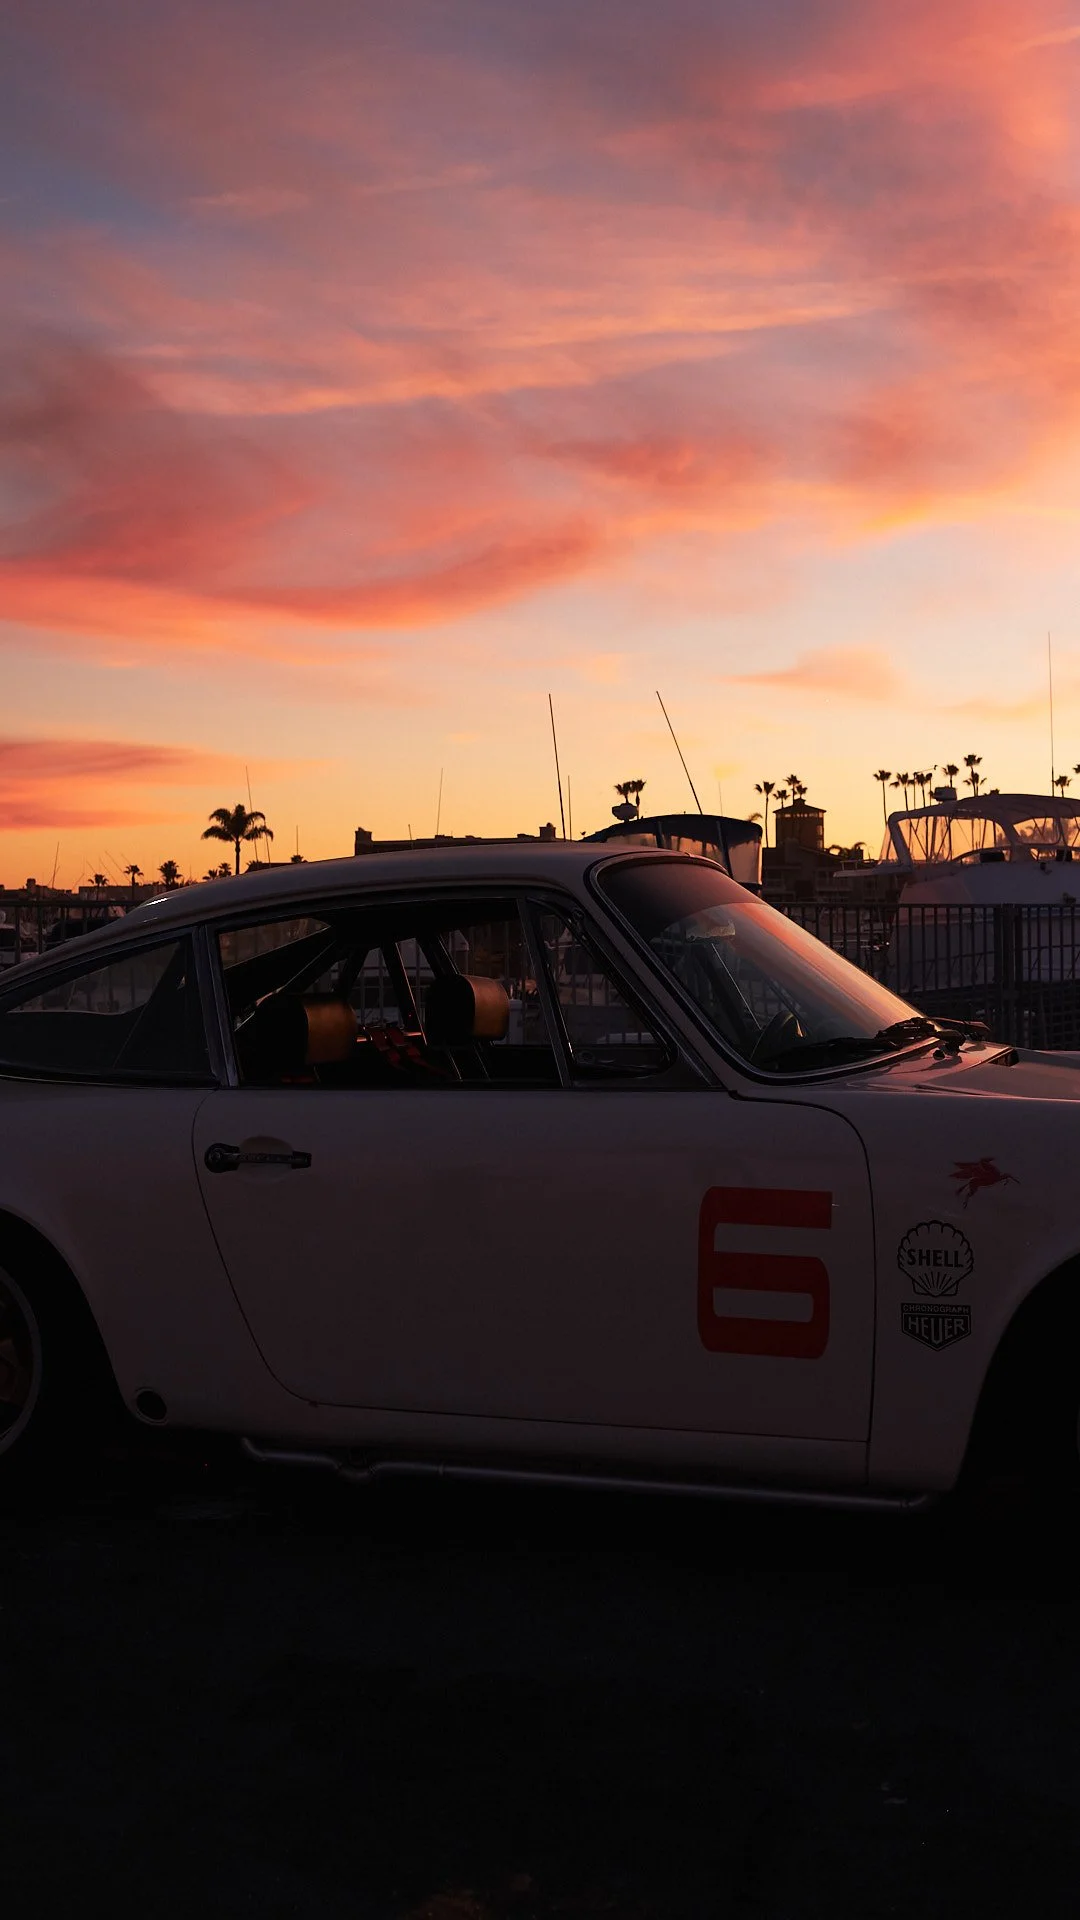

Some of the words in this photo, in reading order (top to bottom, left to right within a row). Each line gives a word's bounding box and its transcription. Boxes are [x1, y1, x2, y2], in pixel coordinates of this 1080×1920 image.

[907, 1248, 963, 1267] SHELL
[698, 1186, 832, 1359] 6
[903, 1303, 970, 1313] CHRONOGRAPH
[908, 1316, 966, 1345] HEUER
